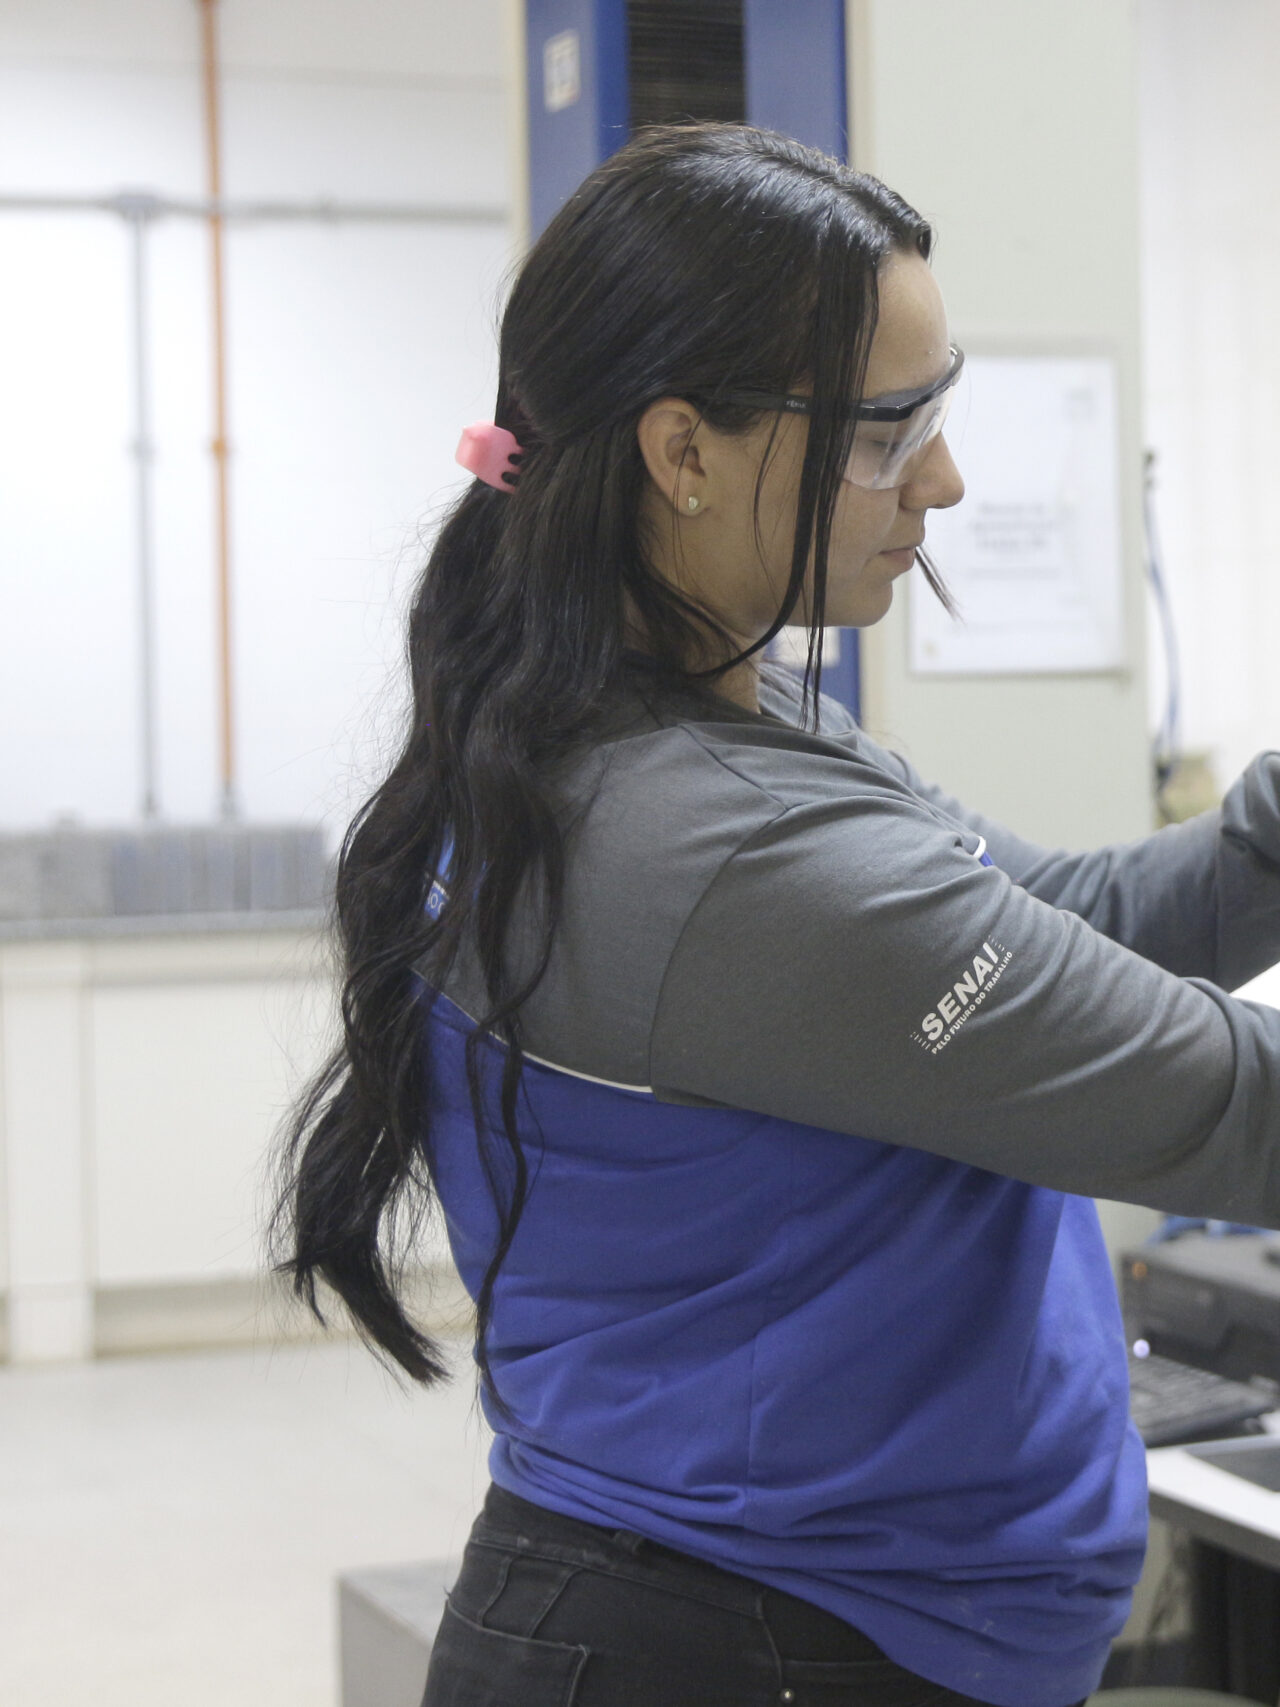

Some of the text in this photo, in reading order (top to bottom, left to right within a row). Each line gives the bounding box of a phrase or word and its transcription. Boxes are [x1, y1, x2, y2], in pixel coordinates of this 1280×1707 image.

[922, 942, 999, 1041] SENAI
[931, 951, 1013, 1055] PELO FUTURO DO TRABALHO
